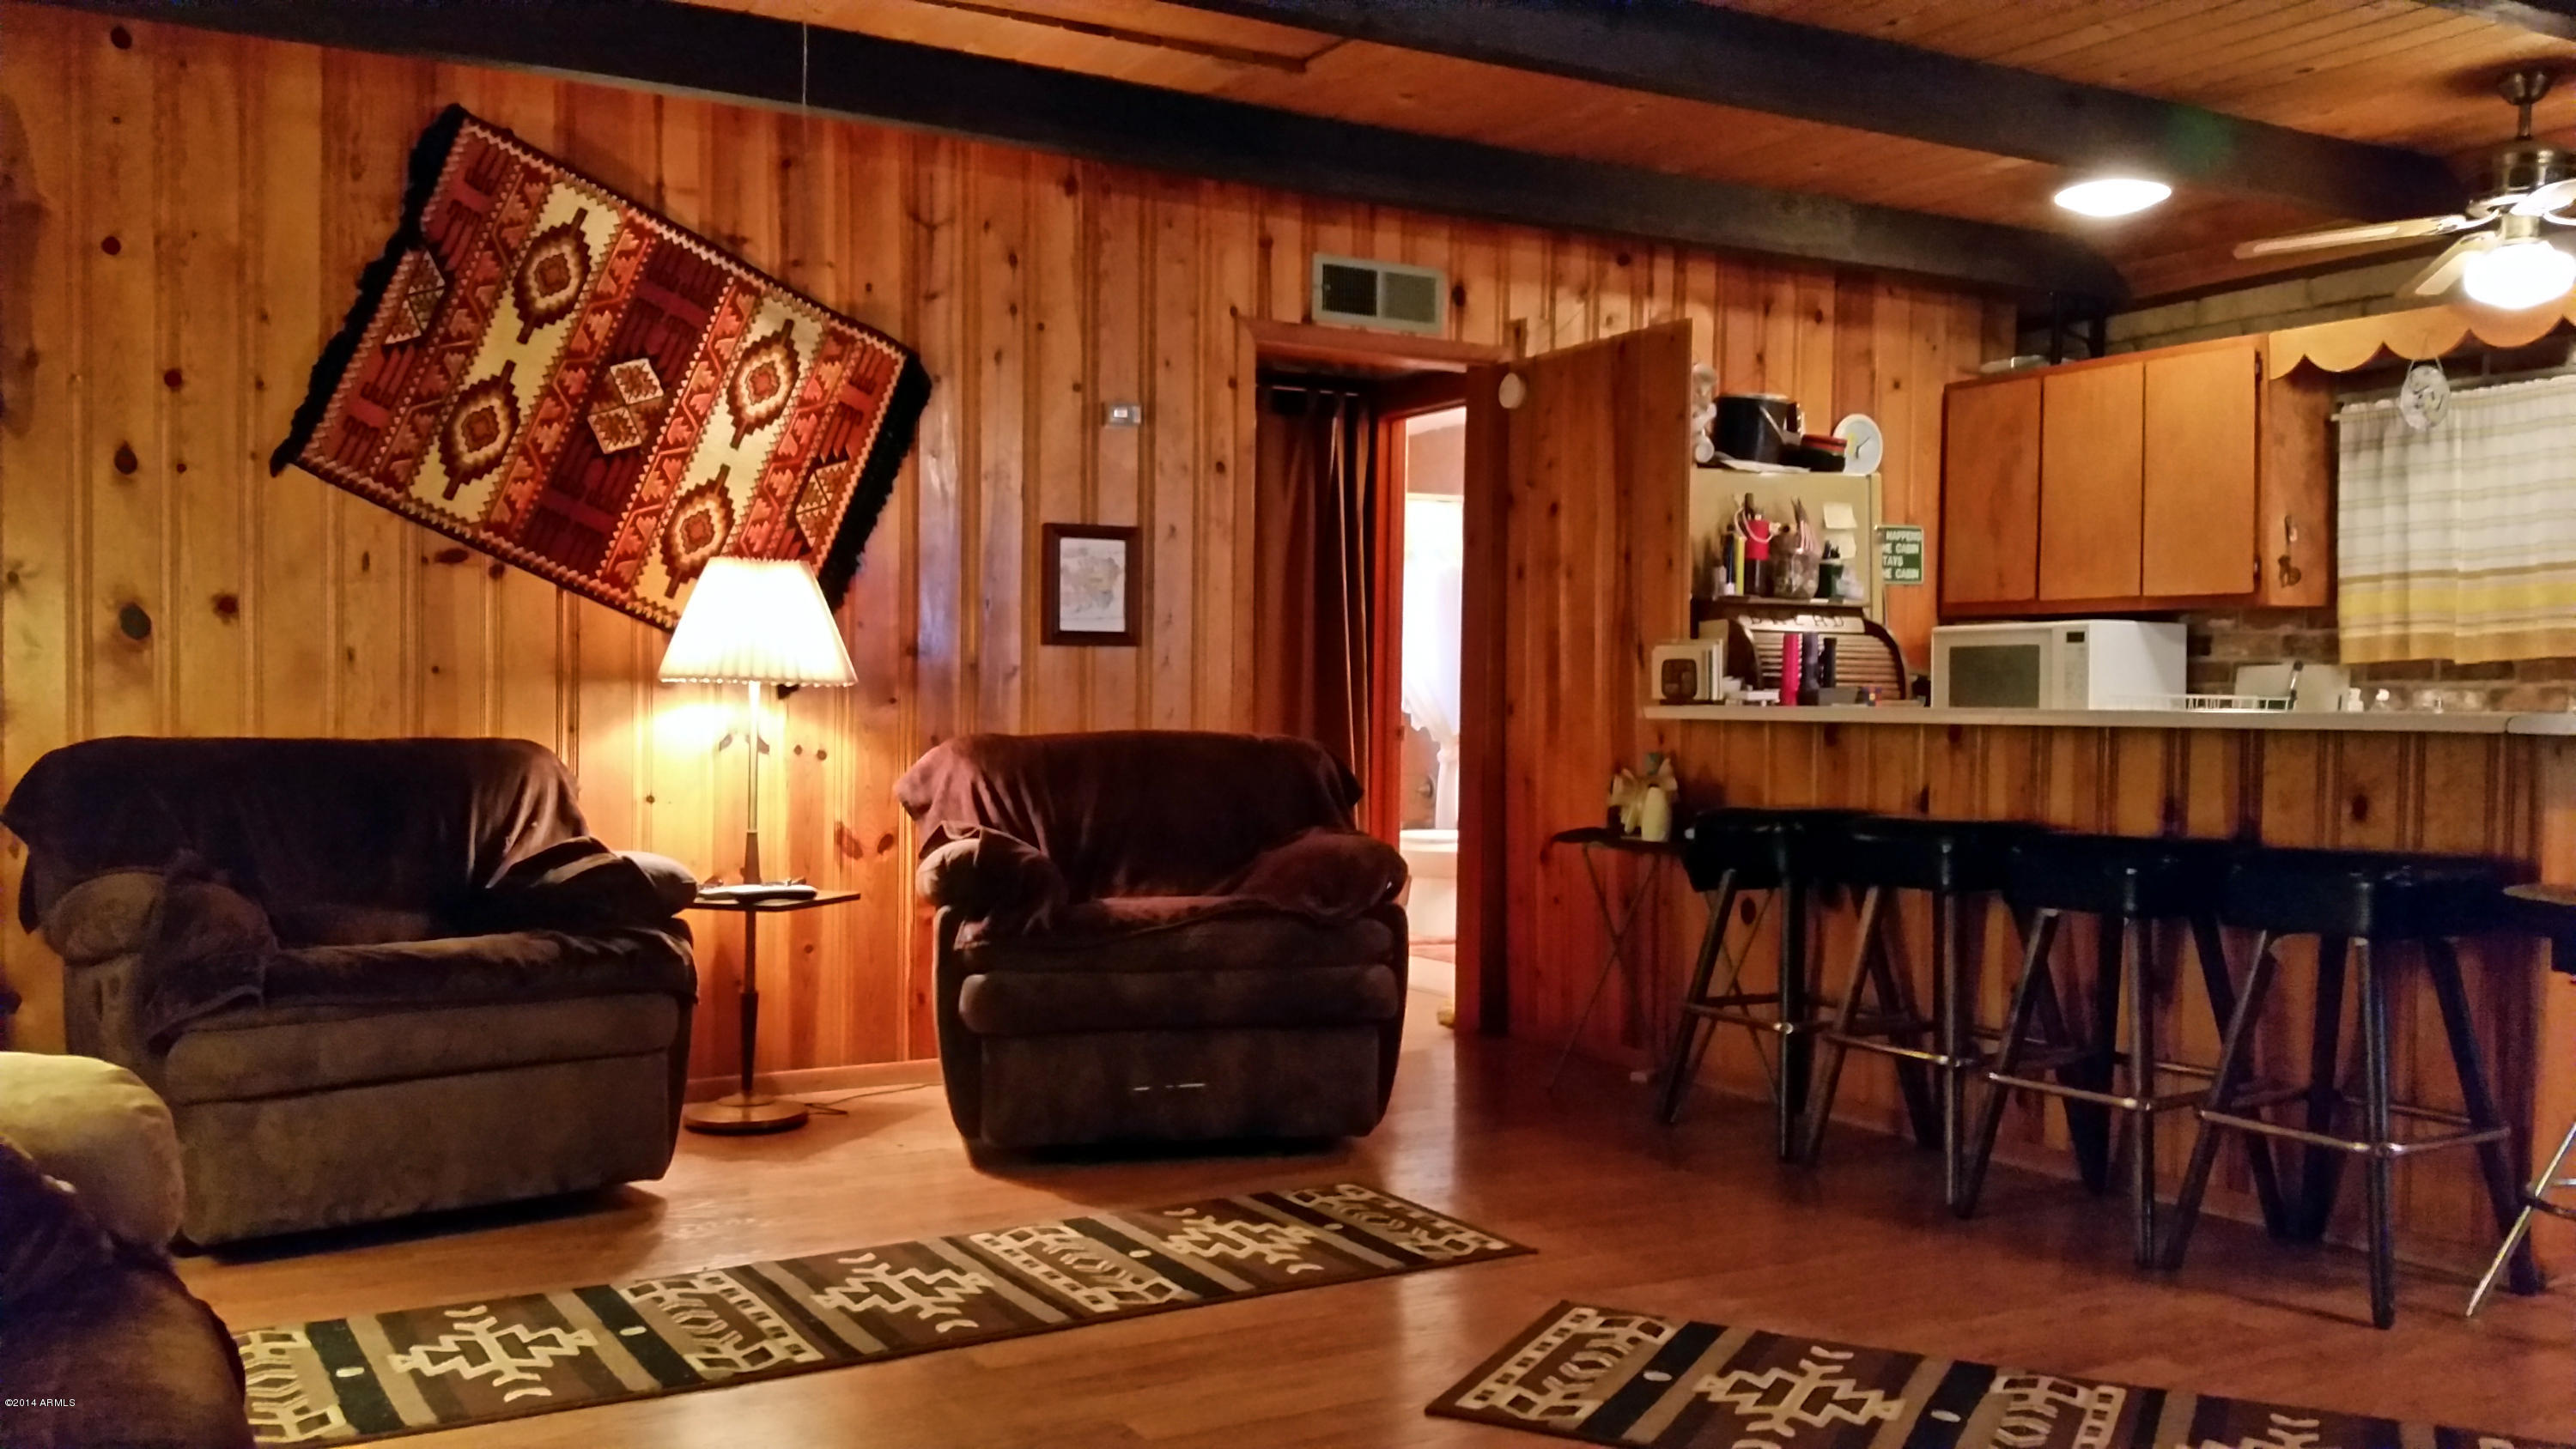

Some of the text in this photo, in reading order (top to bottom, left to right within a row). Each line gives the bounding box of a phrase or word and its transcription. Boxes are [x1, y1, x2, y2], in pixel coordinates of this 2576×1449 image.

[1882, 543, 1893, 555] HE
[1882, 555, 1904, 567] TAYS
[1882, 567, 1893, 579] HE
